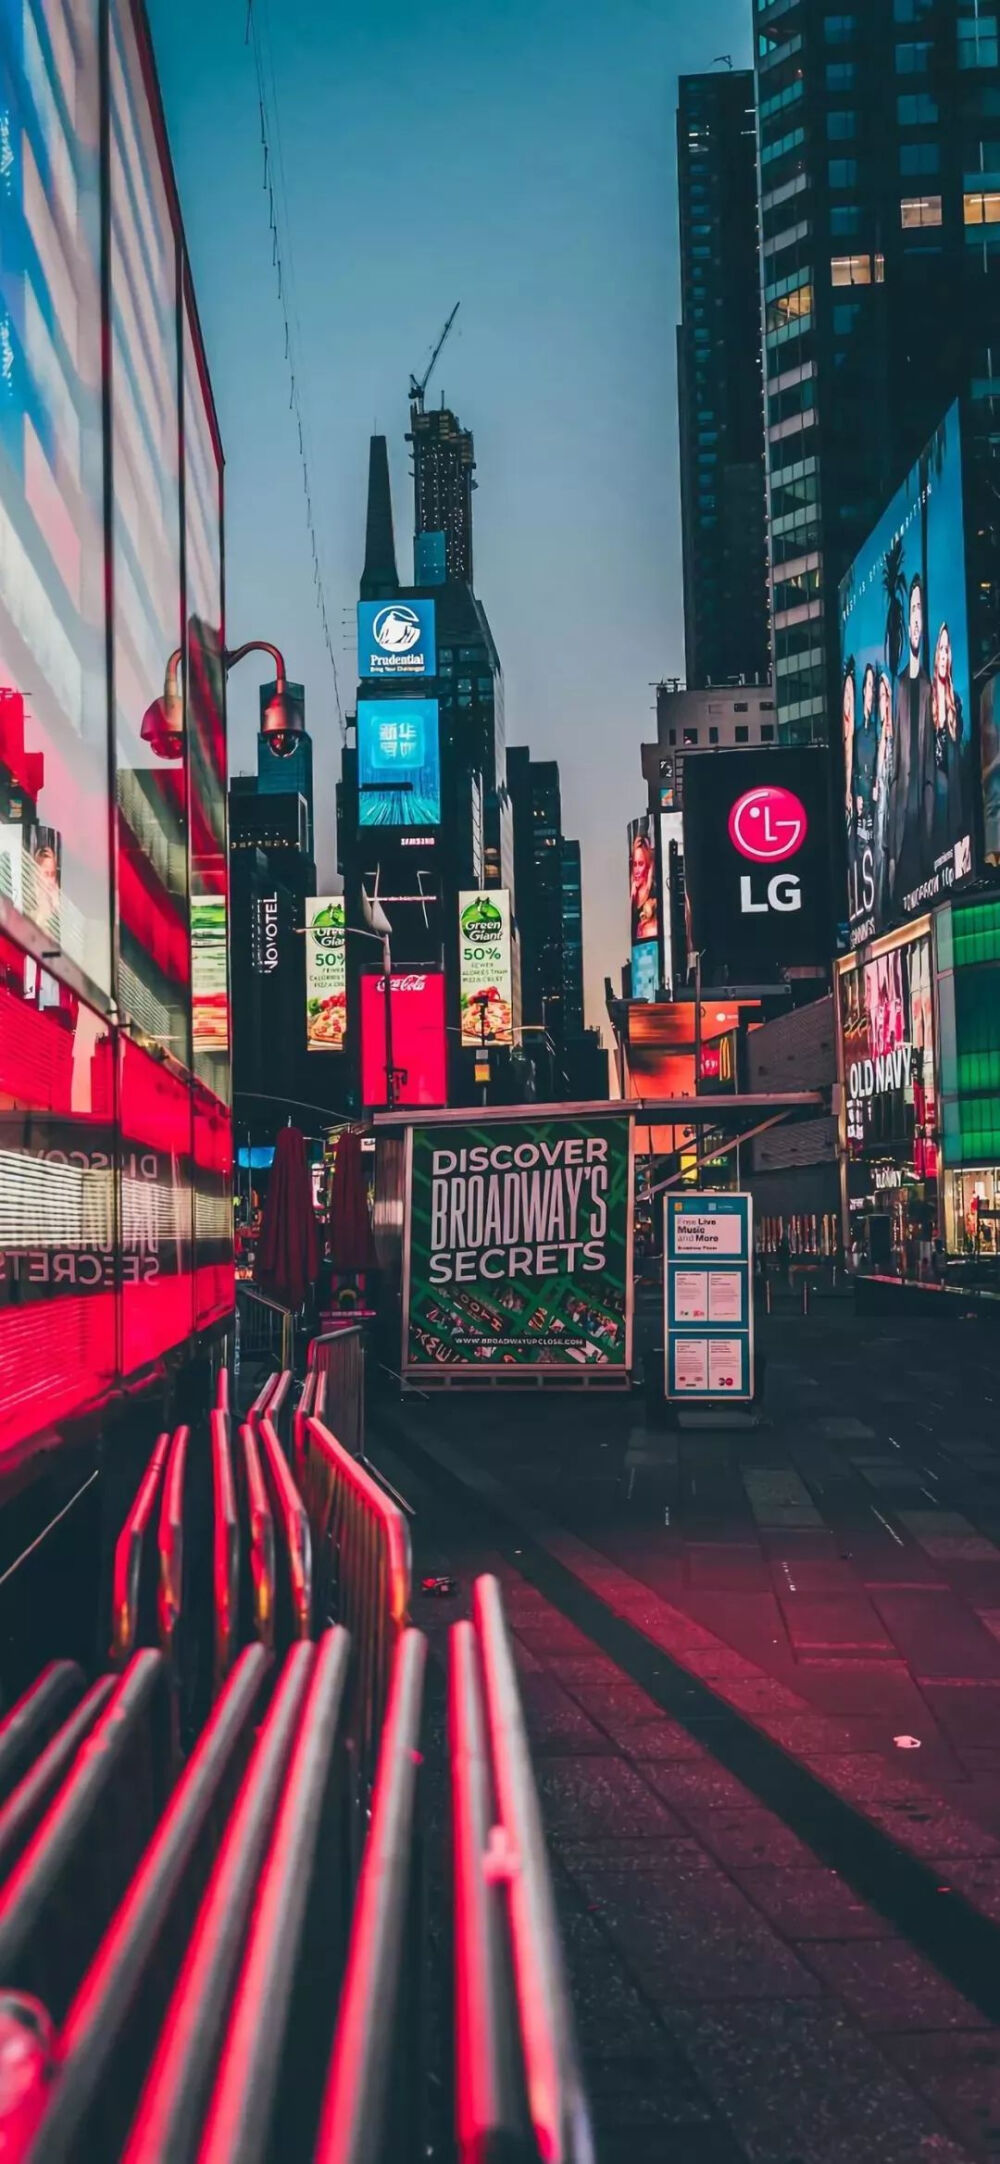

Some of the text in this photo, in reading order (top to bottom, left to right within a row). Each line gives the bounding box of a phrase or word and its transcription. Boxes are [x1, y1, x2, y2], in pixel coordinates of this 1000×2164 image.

[370, 654, 424, 665] Prudential
[740, 874, 801, 913] LG
[263, 892, 278, 973] NOVOTEL
[466, 921, 500, 930] Green
[470, 930, 503, 941] Giant
[464, 948, 501, 960] 50%
[850, 1048, 912, 1100] OLD NAVY
[433, 1138, 608, 1175] DISCOVER
[431, 1165, 608, 1250] BROADWAY'S
[677, 1226, 705, 1234] Music
[429, 1241, 606, 1283] SECRETS
